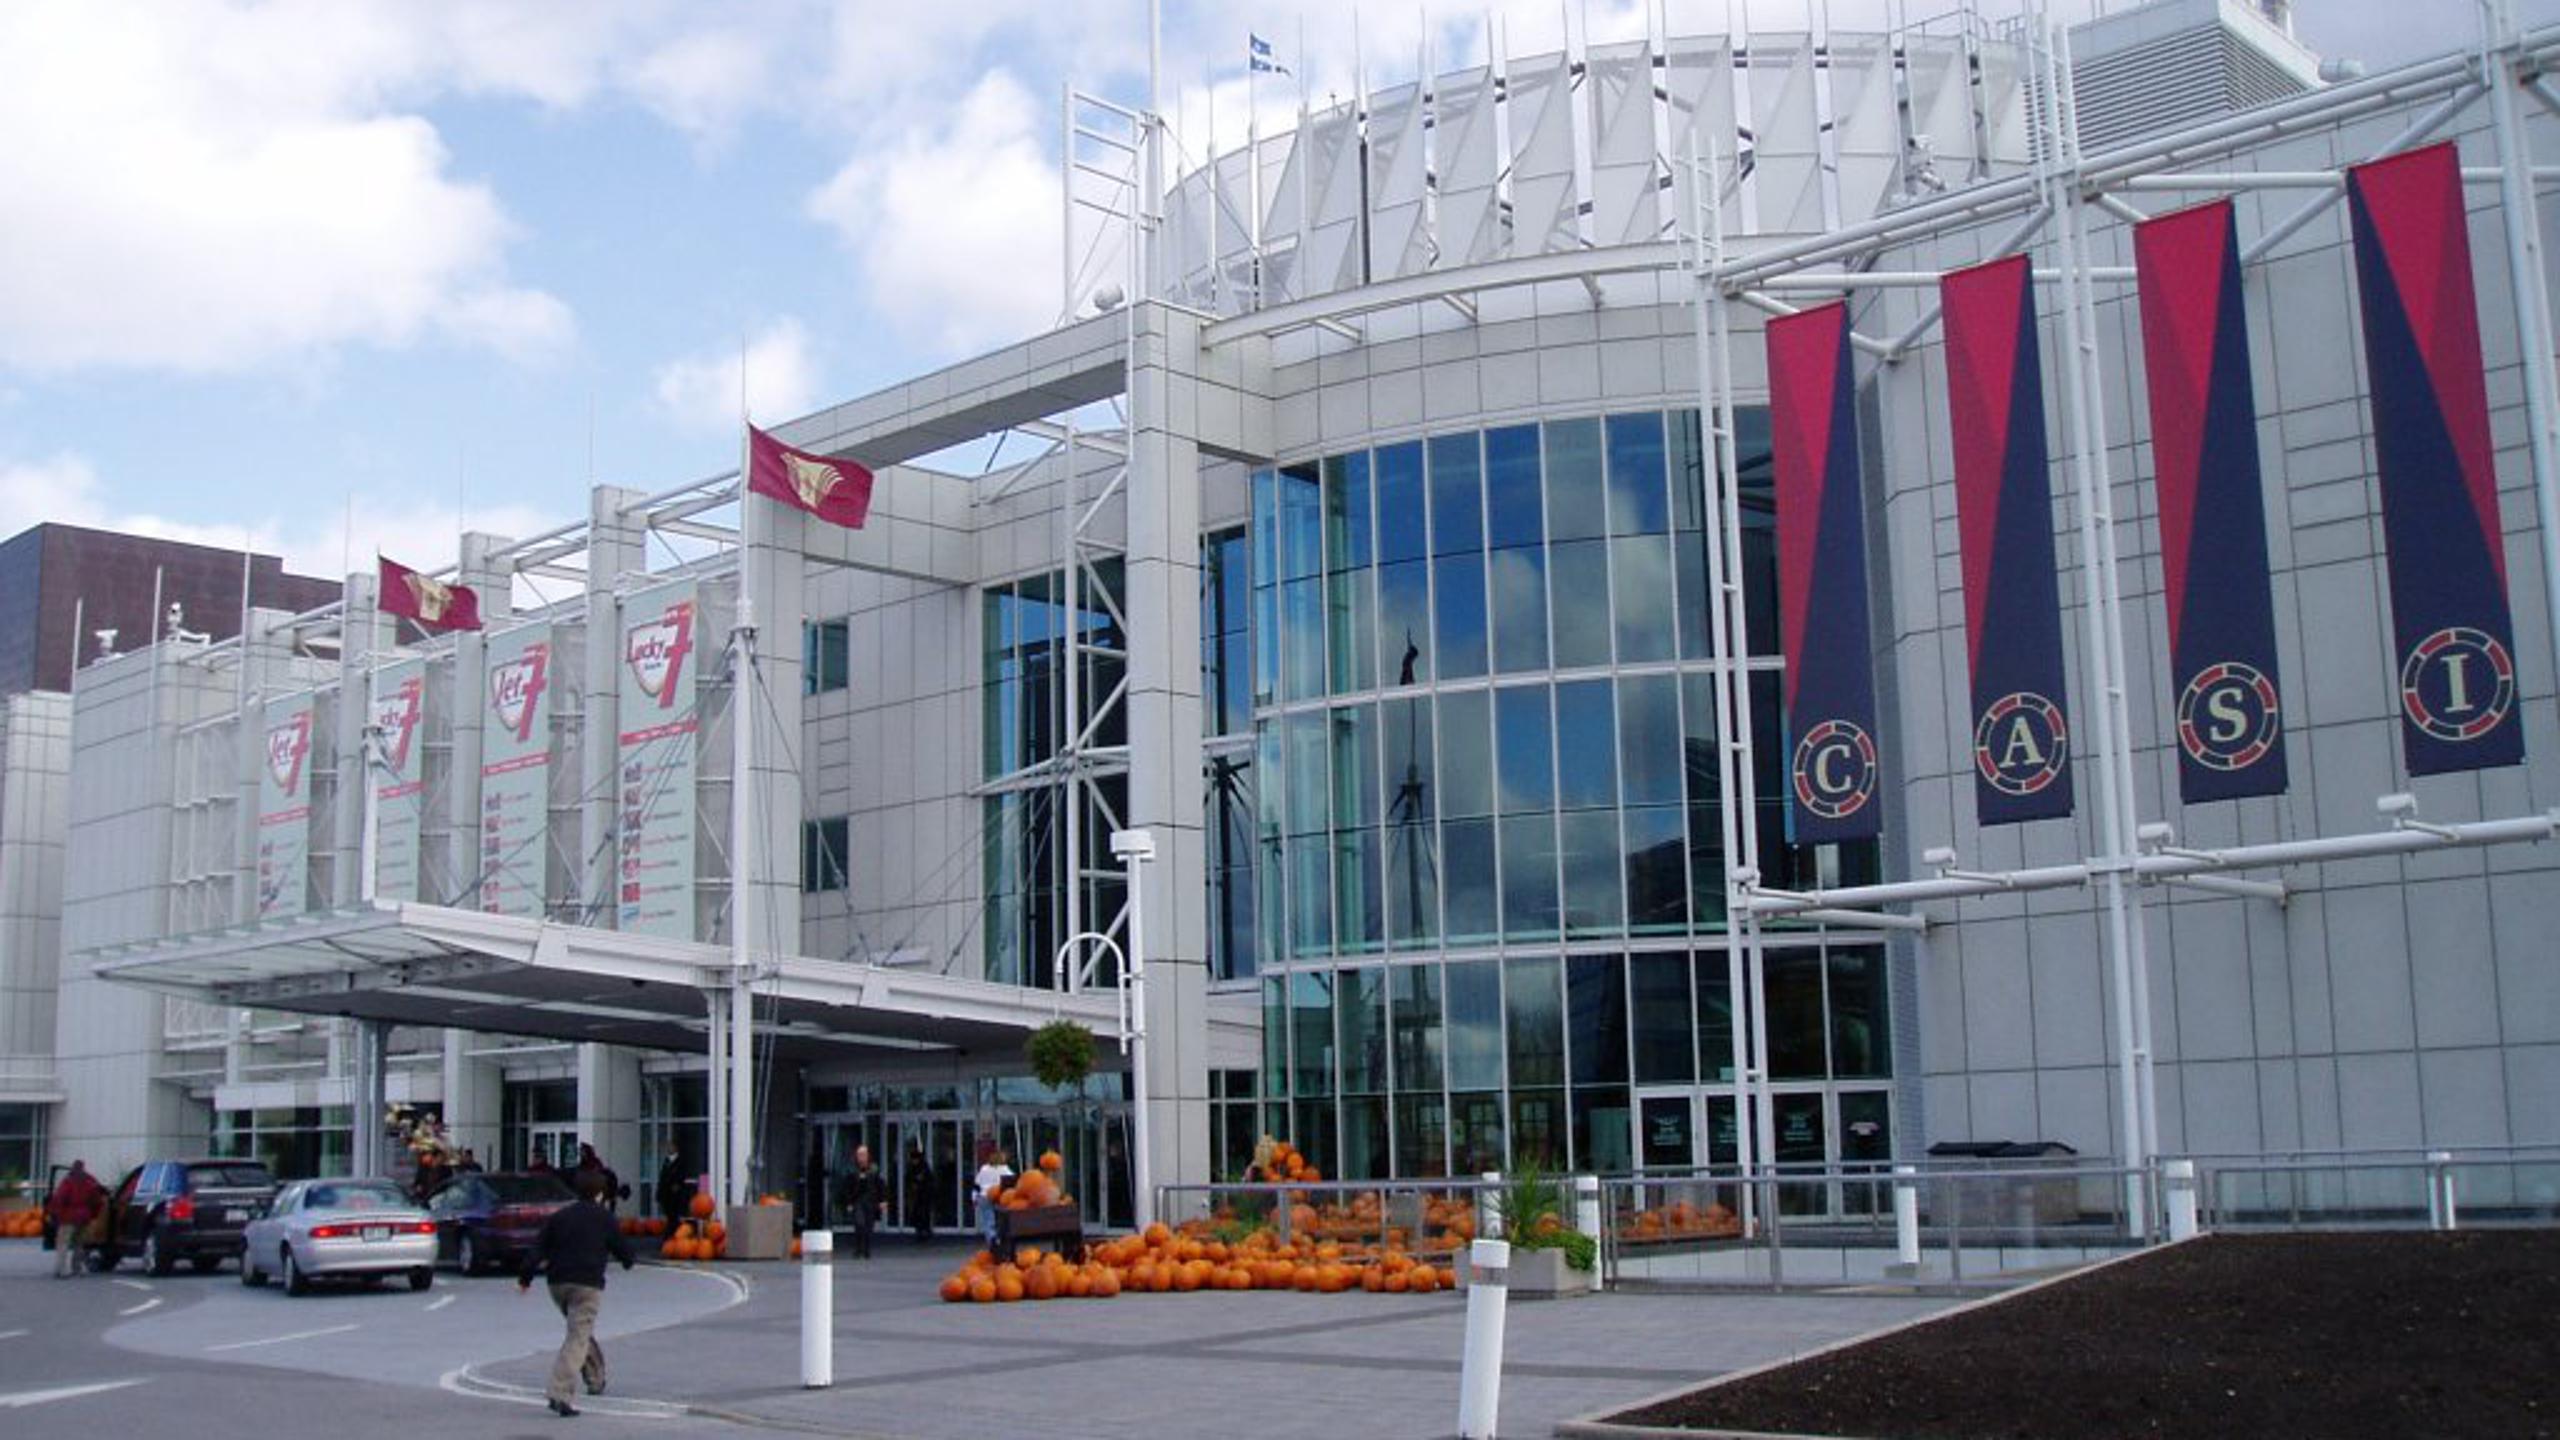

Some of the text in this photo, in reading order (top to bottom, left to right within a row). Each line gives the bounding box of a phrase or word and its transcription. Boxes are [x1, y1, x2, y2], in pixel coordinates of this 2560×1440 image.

[518, 643, 547, 742] 7
[659, 602, 693, 709] 7
[1815, 653, 2475, 793] C A S I
